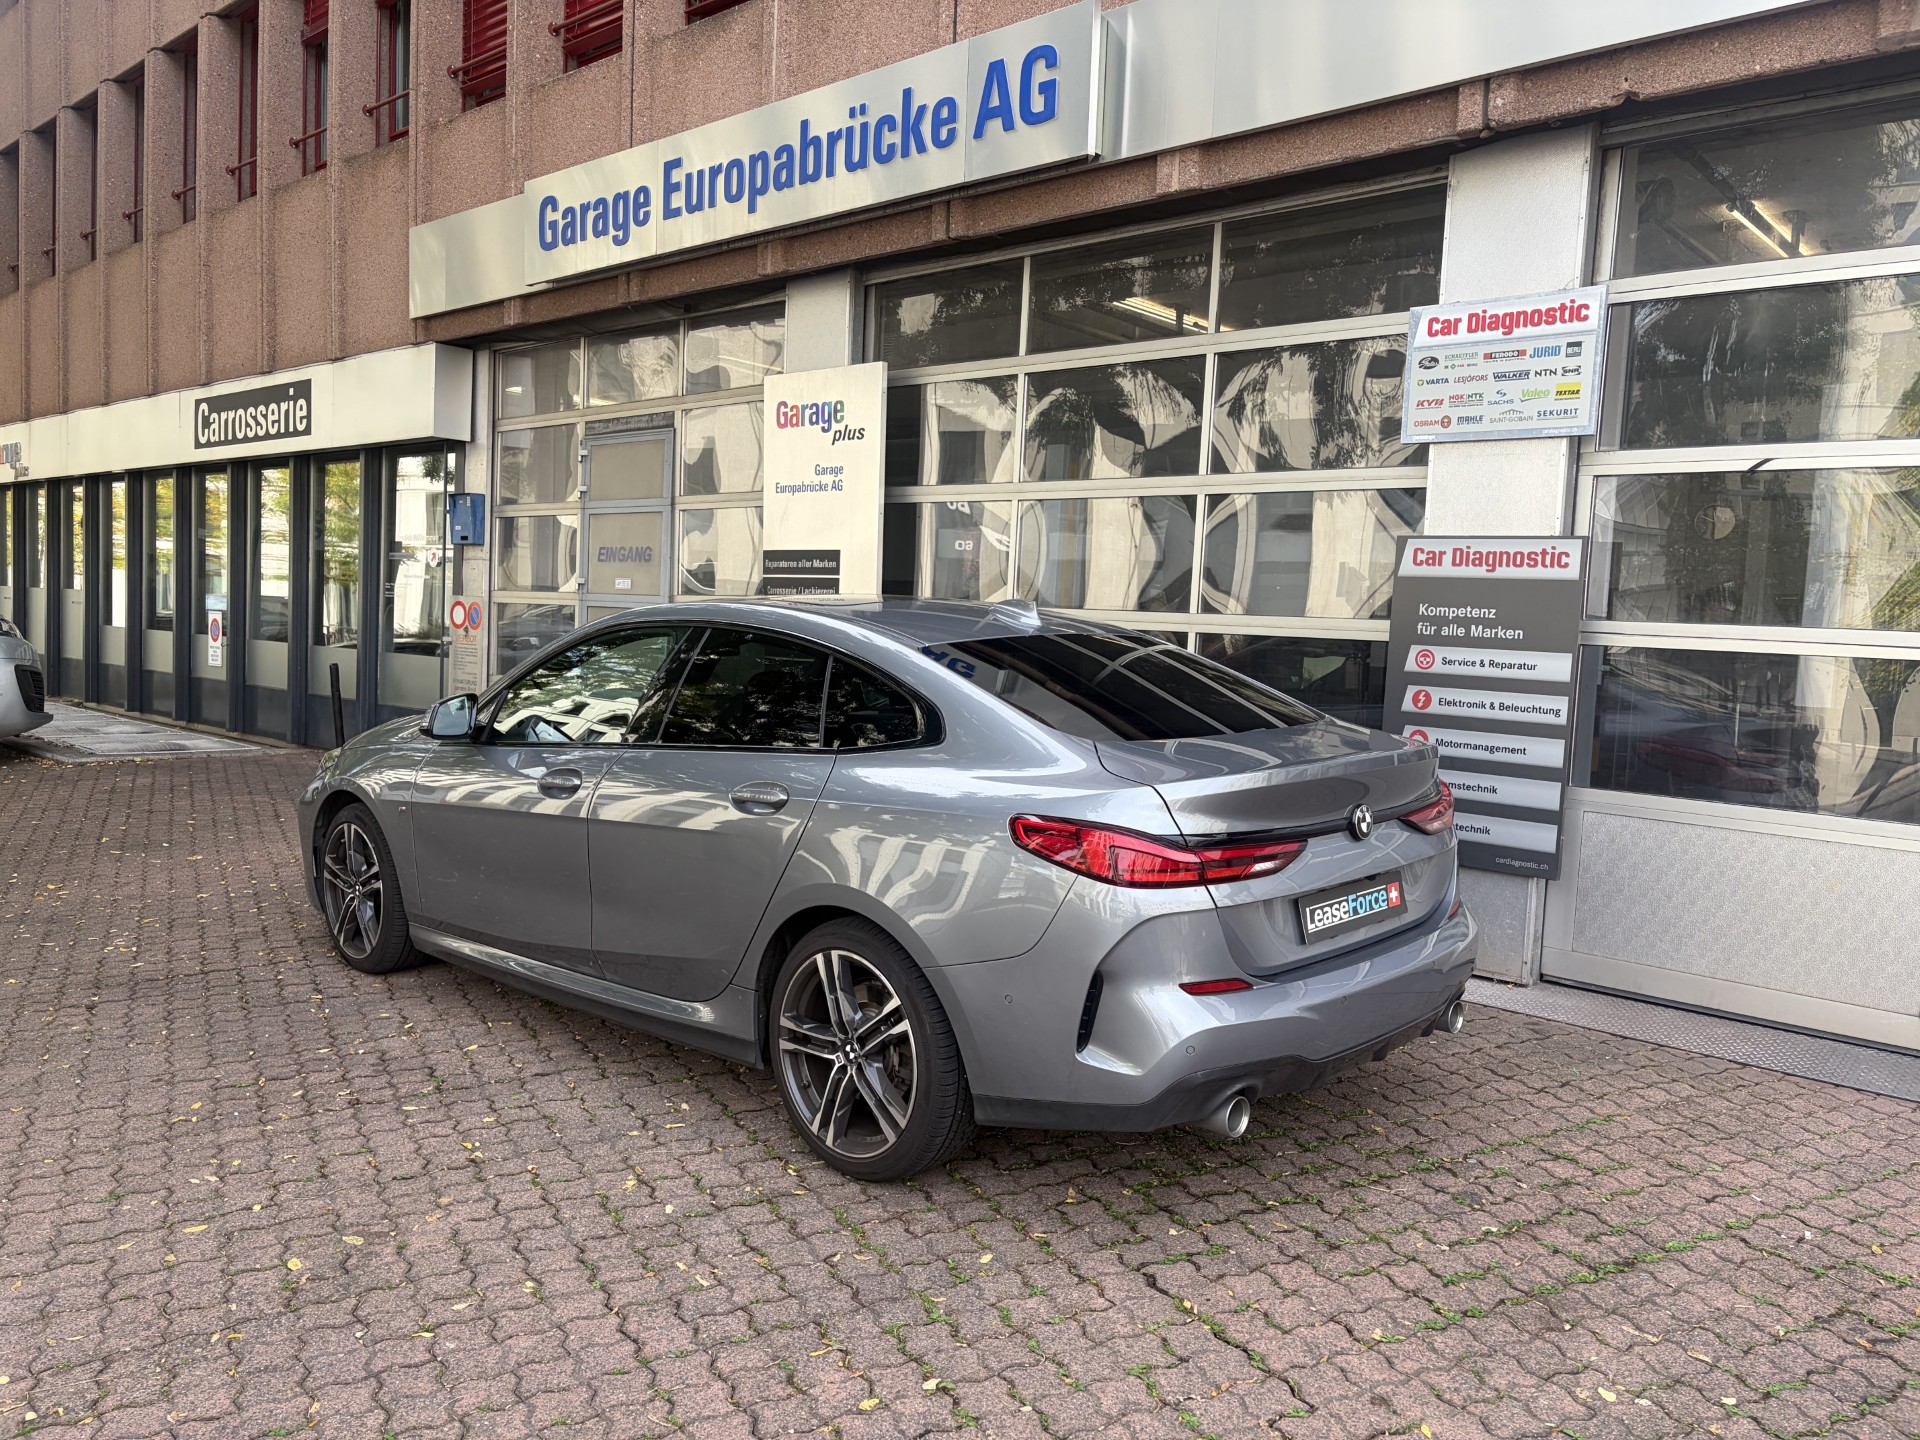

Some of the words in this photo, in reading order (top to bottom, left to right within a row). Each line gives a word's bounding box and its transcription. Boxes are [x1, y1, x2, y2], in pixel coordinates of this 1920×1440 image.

[538, 184, 652, 252] Garage
[660, 86, 959, 215] Europabrücke
[972, 44, 1060, 140] AG
[1427, 316, 1462, 337] Car
[1466, 298, 1590, 336] Diagnostic
[1491, 350, 1518, 359] FERODO
[1529, 345, 1562, 359] JURID
[1493, 370, 1531, 381] WALKER
[1534, 368, 1557, 378] NTN
[1562, 367, 1580, 375] SNR
[1448, 393, 1465, 401] NGK
[1467, 392, 1484, 400] NTK
[1521, 387, 1550, 399] Valeo
[1555, 389, 1581, 397] TEXTAR
[1416, 398, 1445, 407] KYB
[1487, 398, 1514, 406] SACHS
[197, 387, 308, 446] Carrosserie
[776, 399, 846, 434] Garage
[1536, 407, 1579, 417] SEKURIT
[1414, 419, 1440, 428] OSRAM
[1489, 415, 1534, 424] SAINT-GOBAIN
[832, 424, 866, 446] plus
[814, 463, 844, 477] Garage
[775, 481, 829, 496] Europabrücke
[830, 479, 844, 492] AG
[597, 546, 653, 563] EINGANG
[1412, 547, 1447, 568] Car
[1451, 545, 1570, 573] Diagnostic
[765, 559, 797, 570] Reparaturen
[798, 559, 812, 568] aller
[813, 559, 837, 568] Marken
[767, 585, 797, 595] Carrosserie
[1418, 603, 1497, 620] Kompetenz
[1417, 622, 1436, 636] für
[1440, 623, 1465, 637] alle
[1470, 624, 1524, 640] Marken
[1441, 656, 1476, 668] Service
[1479, 659, 1486, 668] &
[1488, 659, 1538, 672] Reparatur
[1438, 697, 1486, 710] Elektronik
[1489, 701, 1496, 710] &
[1498, 702, 1562, 718] Beleuchtung
[1435, 737, 1527, 756] Motormanagement
[1448, 782, 1498, 794] mstechnik
[1455, 823, 1491, 836] technik
[1495, 855, 1549, 871] cardiagnostic.ch
[1305, 887, 1388, 931] LeaseForce
